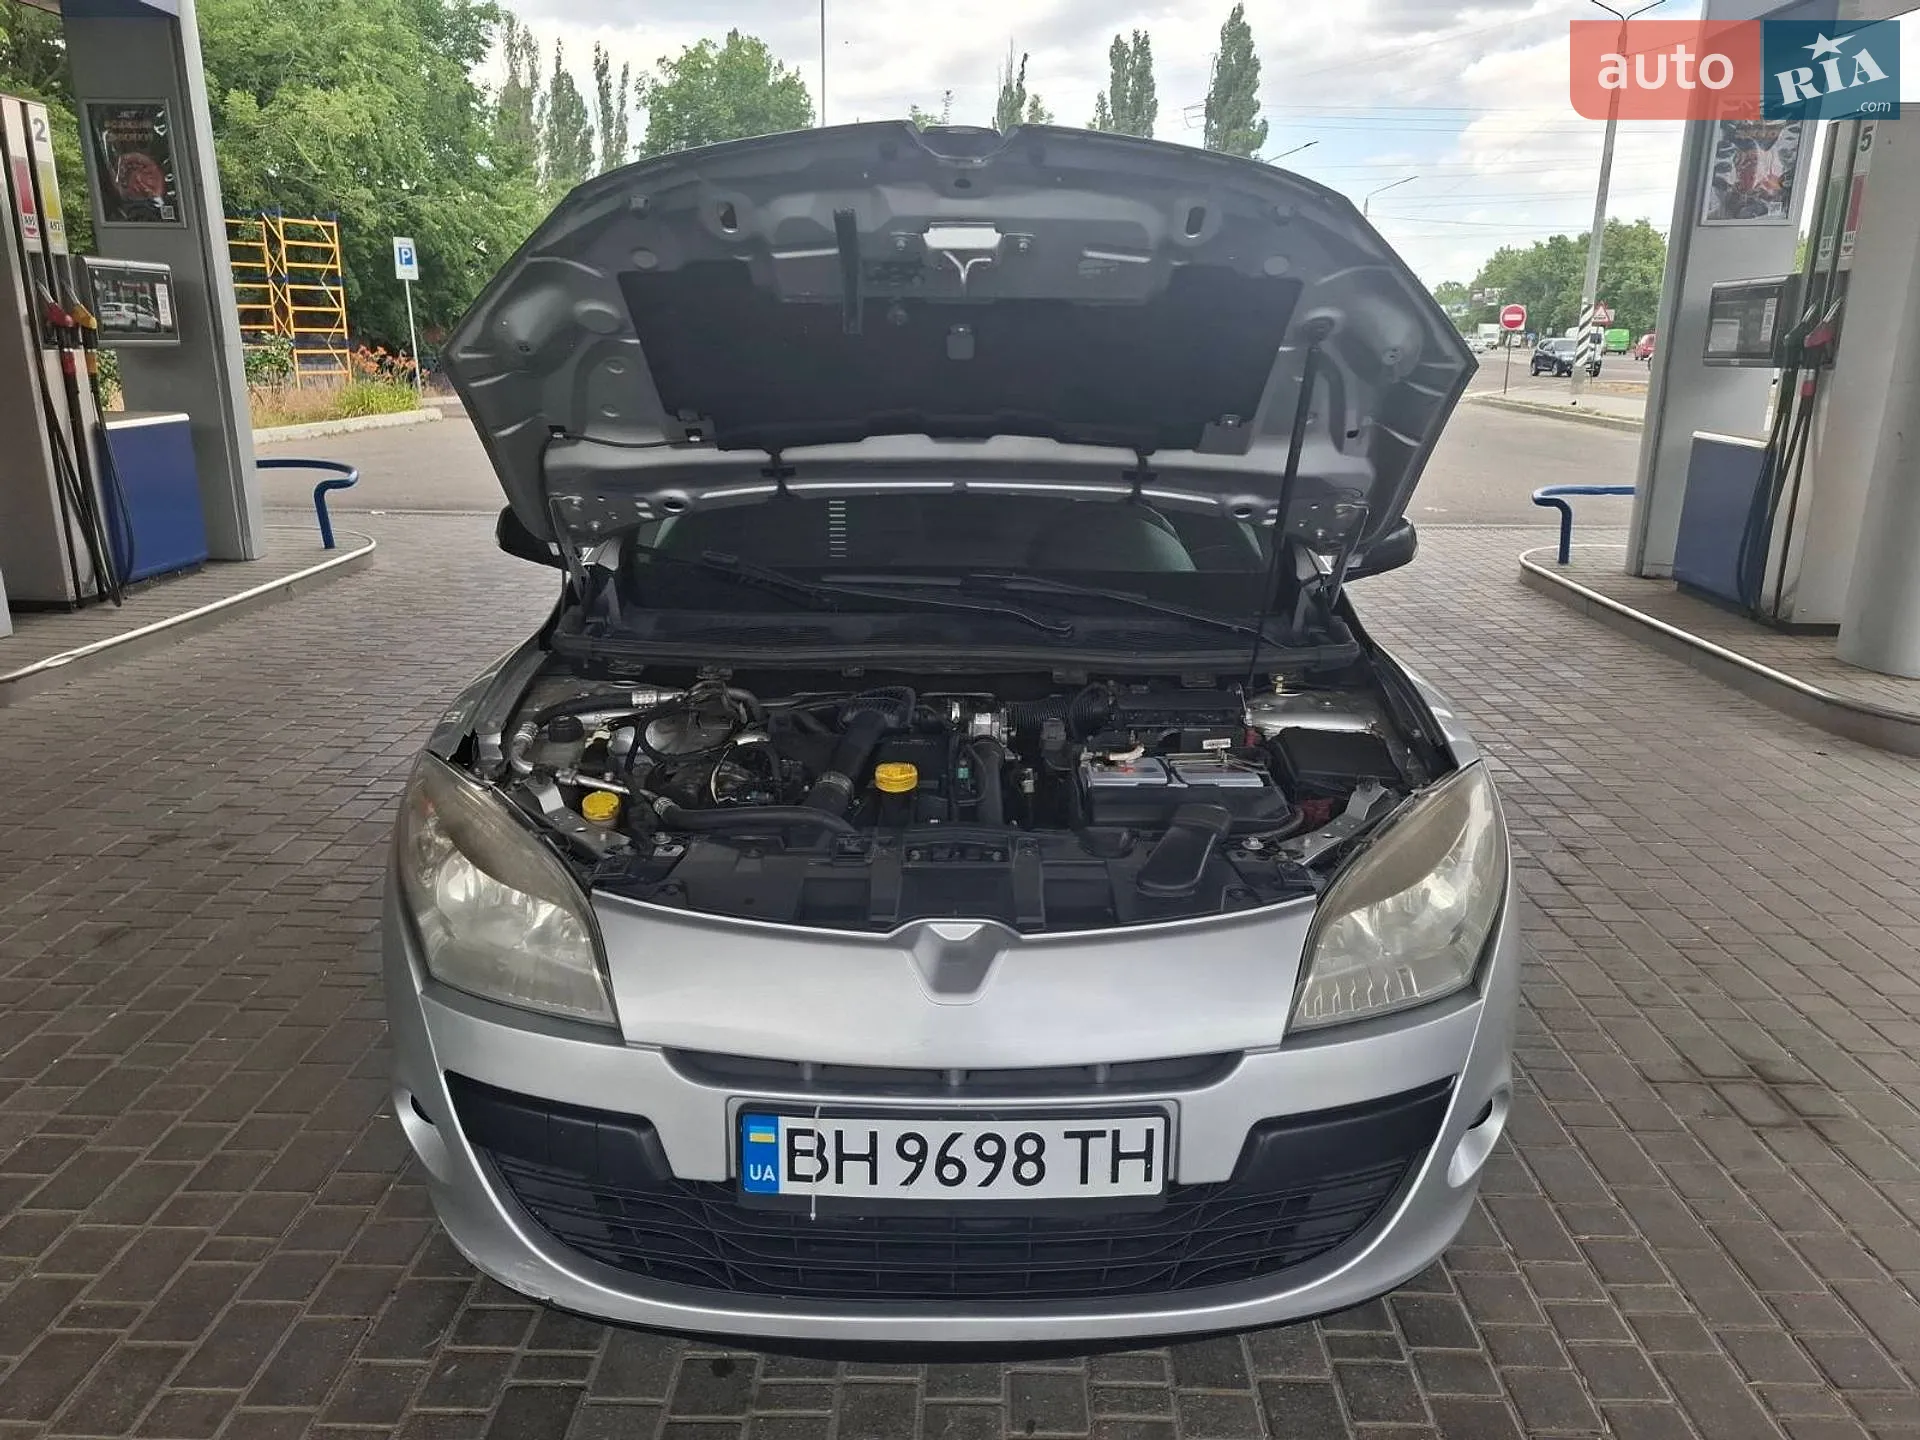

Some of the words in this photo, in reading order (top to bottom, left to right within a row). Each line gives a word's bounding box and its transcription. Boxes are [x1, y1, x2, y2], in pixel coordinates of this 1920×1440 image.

[33, 118, 47, 142] 2
[1860, 125, 1874, 152] 5
[786, 1128, 878, 1185] BH
[895, 1132, 1046, 1187] 9698
[1063, 1128, 1155, 1184] TH
[750, 1164, 776, 1182] UA
